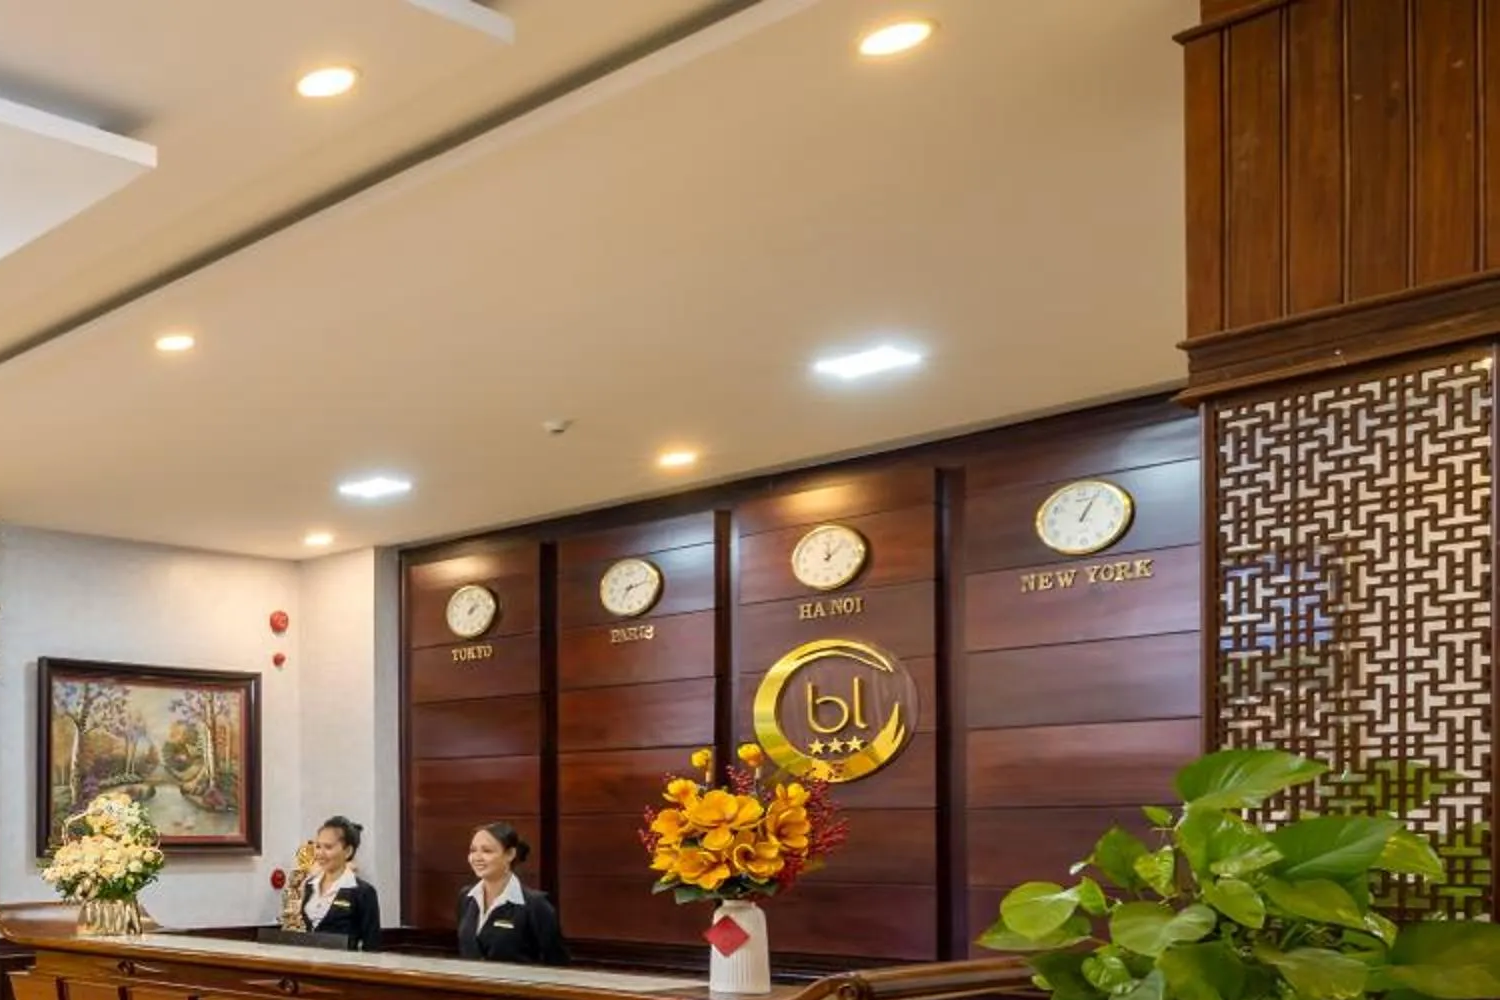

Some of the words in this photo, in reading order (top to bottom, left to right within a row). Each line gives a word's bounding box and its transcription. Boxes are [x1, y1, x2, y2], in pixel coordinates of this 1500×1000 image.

[1020, 569, 1077, 593] NEW
[1085, 559, 1155, 583] YORK
[610, 625, 654, 644] PARIS
[451, 645, 493, 662] TOKYO
